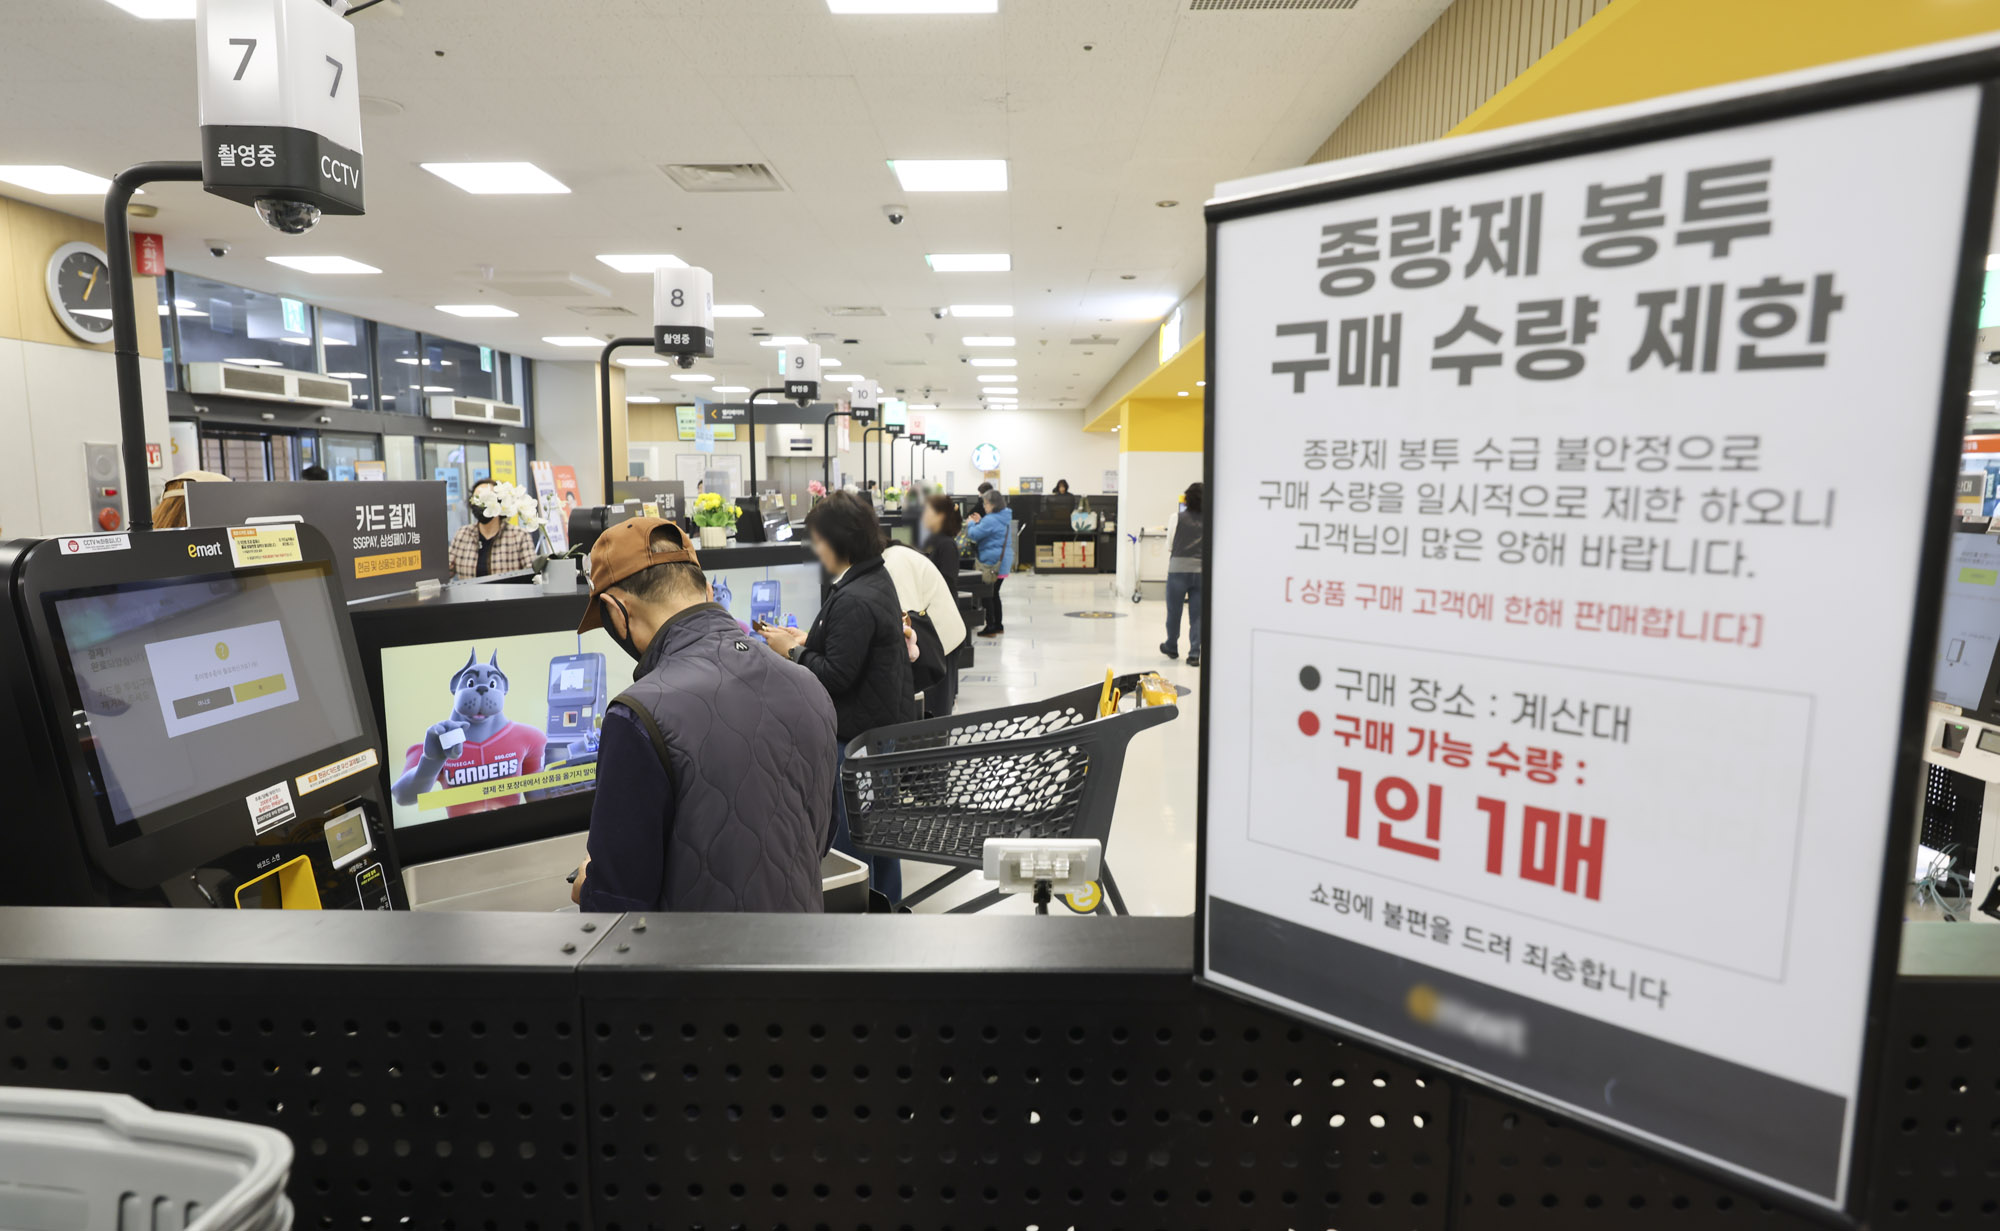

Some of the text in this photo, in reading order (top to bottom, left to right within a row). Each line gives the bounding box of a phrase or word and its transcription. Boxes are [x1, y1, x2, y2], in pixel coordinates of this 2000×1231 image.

[229, 38, 257, 81] 7
[326, 54, 344, 98] 7
[218, 143, 277, 168] 촬영중
[321, 155, 360, 189] CCTV
[1317, 158, 1773, 298] 종량제 봉투
[670, 288, 684, 308] 8
[663, 333, 690, 345] 촬영중
[1272, 273, 1845, 394] 구매 수량 제한
[795, 356, 804, 369] 9
[857, 389, 869, 400] 10
[1304, 435, 1761, 472] 종량제 봉투 수급 불안정으로
[355, 503, 416, 531] 카드 결제
[1259, 481, 1836, 528] 구매 수량을 일시적으로 제한 하오니
[187, 541, 223, 558] emart
[353, 531, 420, 550] SSGPAY, 삼성페이 가능
[1296, 522, 1754, 578] 고객님의 많은 양해 바랍니다.
[358, 561, 370, 574] 현금
[371, 560, 377, 572] 및
[1301, 580, 1345, 607] 상품
[1355, 584, 1403, 612] 구매
[1412, 588, 1494, 621] 고객에
[1505, 596, 1563, 628] 한해
[1575, 601, 1764, 648] 판매합니다]
[1336, 668, 1395, 707] 구매
[1409, 678, 1475, 718] 장소
[1512, 692, 1631, 744] 계산대
[494, 752, 517, 760] SSG.COM
[1334, 714, 1394, 754] 구매
[1407, 727, 1473, 768] 가능
[1487, 742, 1563, 784] 수량
[445, 758, 519, 786] LANDERS
[482, 784, 497, 795] 결제
[498, 782, 505, 793] 전
[506, 778, 541, 791] 포장대에서
[541, 774, 562, 785] 상품을
[563, 770, 583, 781] 옮기지
[1337, 767, 1606, 901] 1인 1매
[1310, 883, 1671, 1009] 쇼핑에 불편을 드려 죄송합니다
